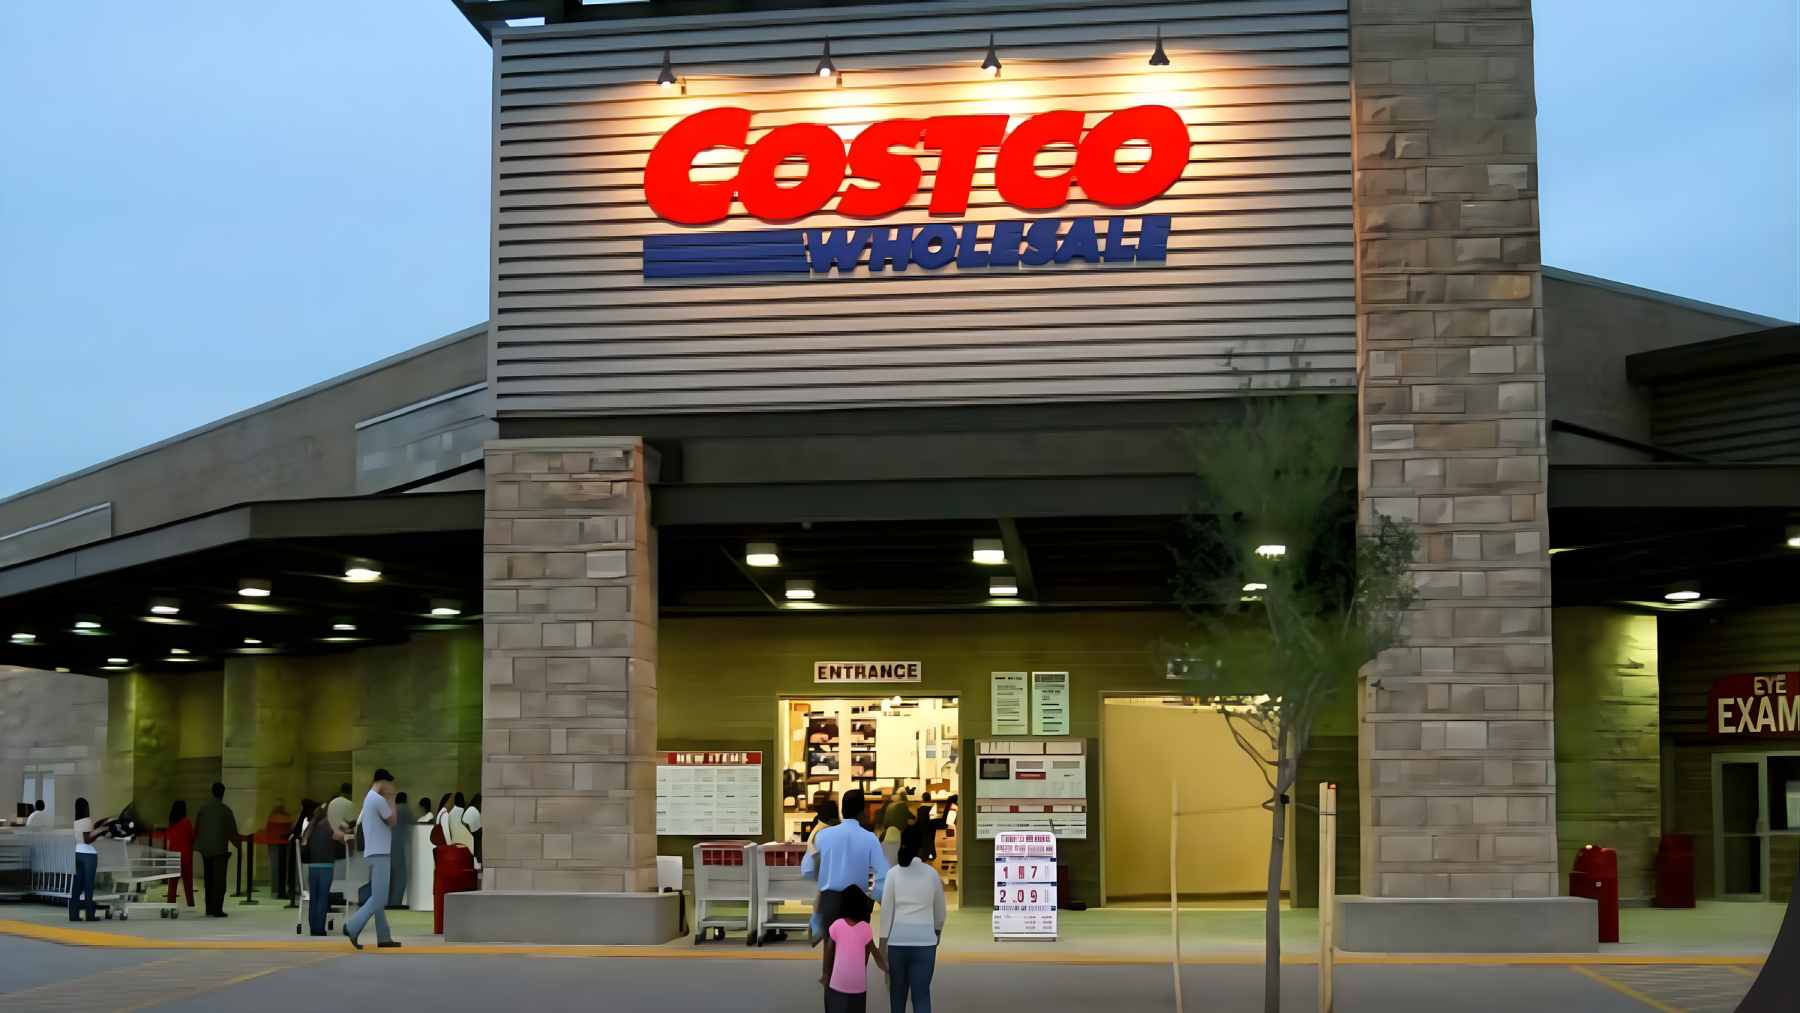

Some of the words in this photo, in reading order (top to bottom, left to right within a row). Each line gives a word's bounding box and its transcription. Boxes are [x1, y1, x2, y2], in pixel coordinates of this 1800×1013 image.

[643, 104, 1191, 225] COSTCO
[805, 214, 1172, 275] WHOLESALE
[817, 664, 918, 680] ENTRANCE
[1754, 674, 1787, 696] EYE
